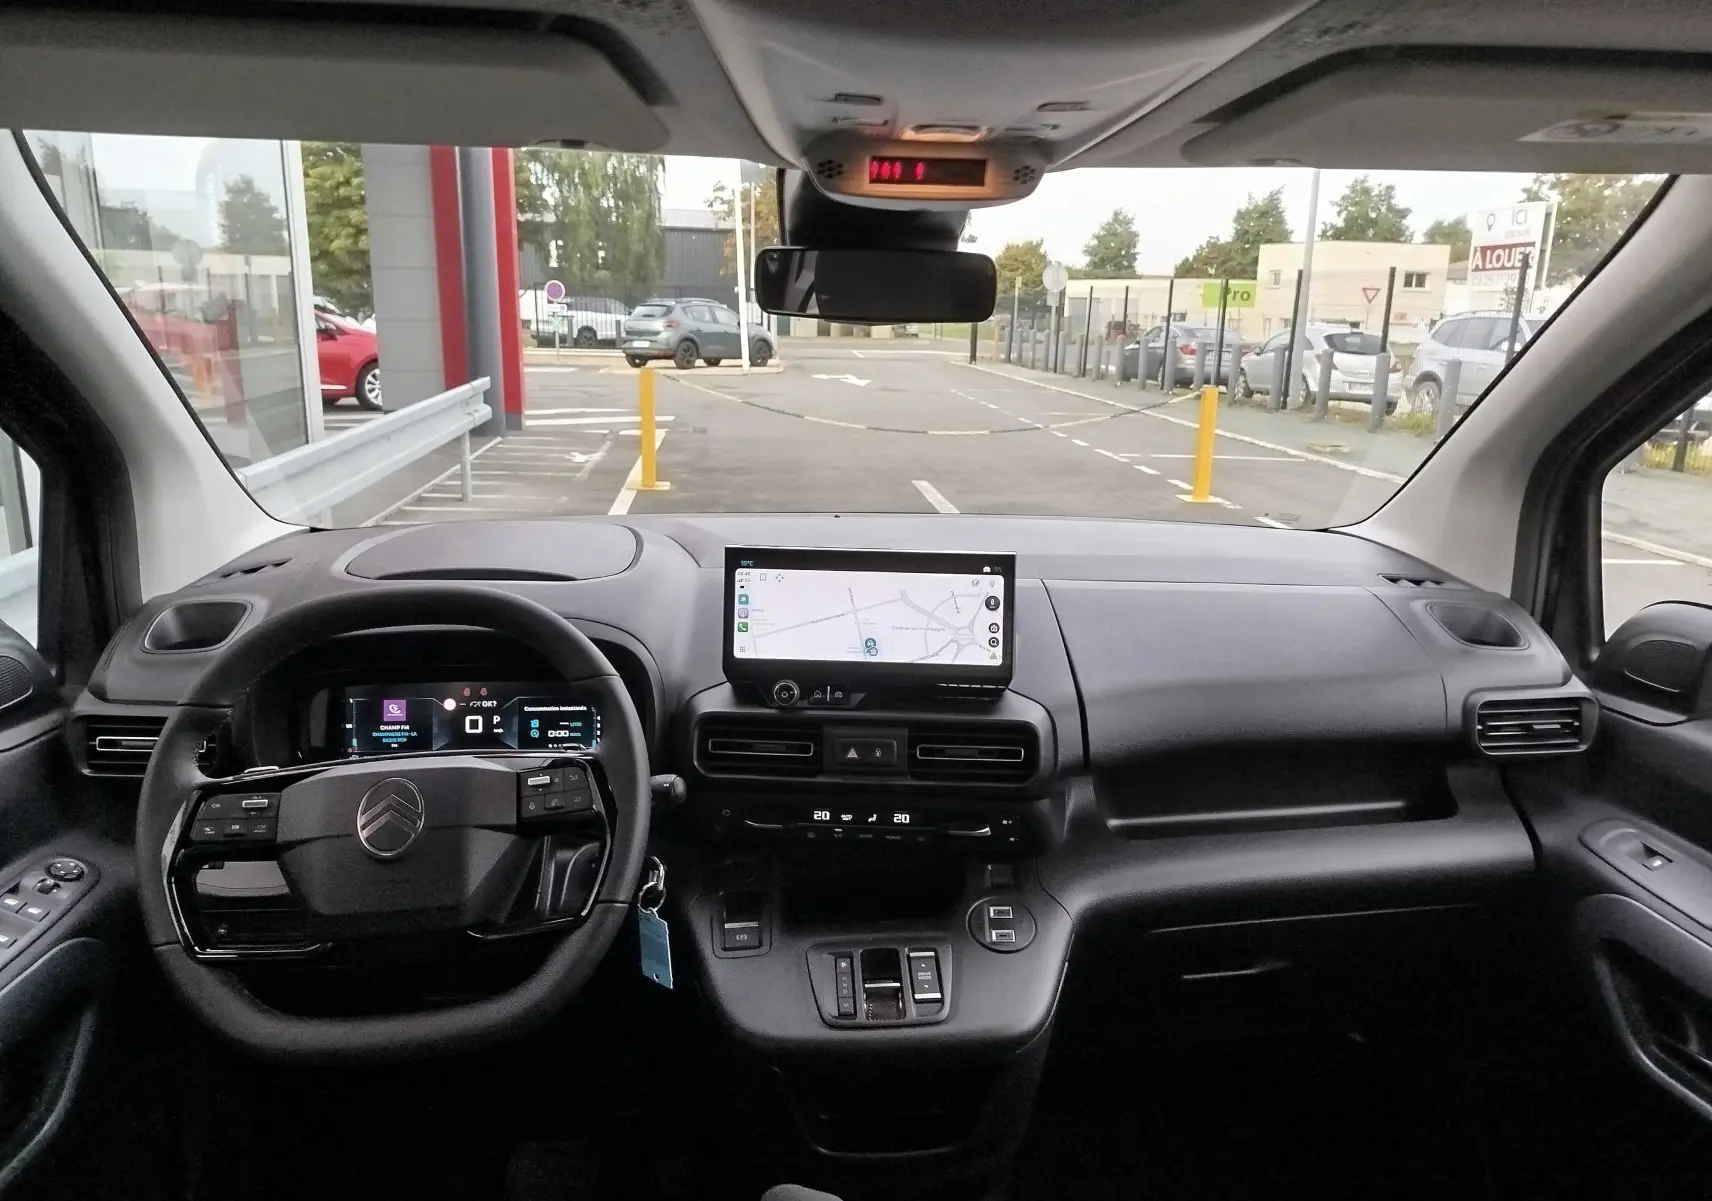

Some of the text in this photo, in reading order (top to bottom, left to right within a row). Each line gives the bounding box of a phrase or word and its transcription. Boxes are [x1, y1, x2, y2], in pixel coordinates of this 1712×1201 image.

[1511, 208, 1528, 226] ICI
[481, 700, 498, 708] OK?
[465, 715, 501, 734] 0 P
[813, 810, 831, 821] 20
[893, 813, 911, 824] 20
